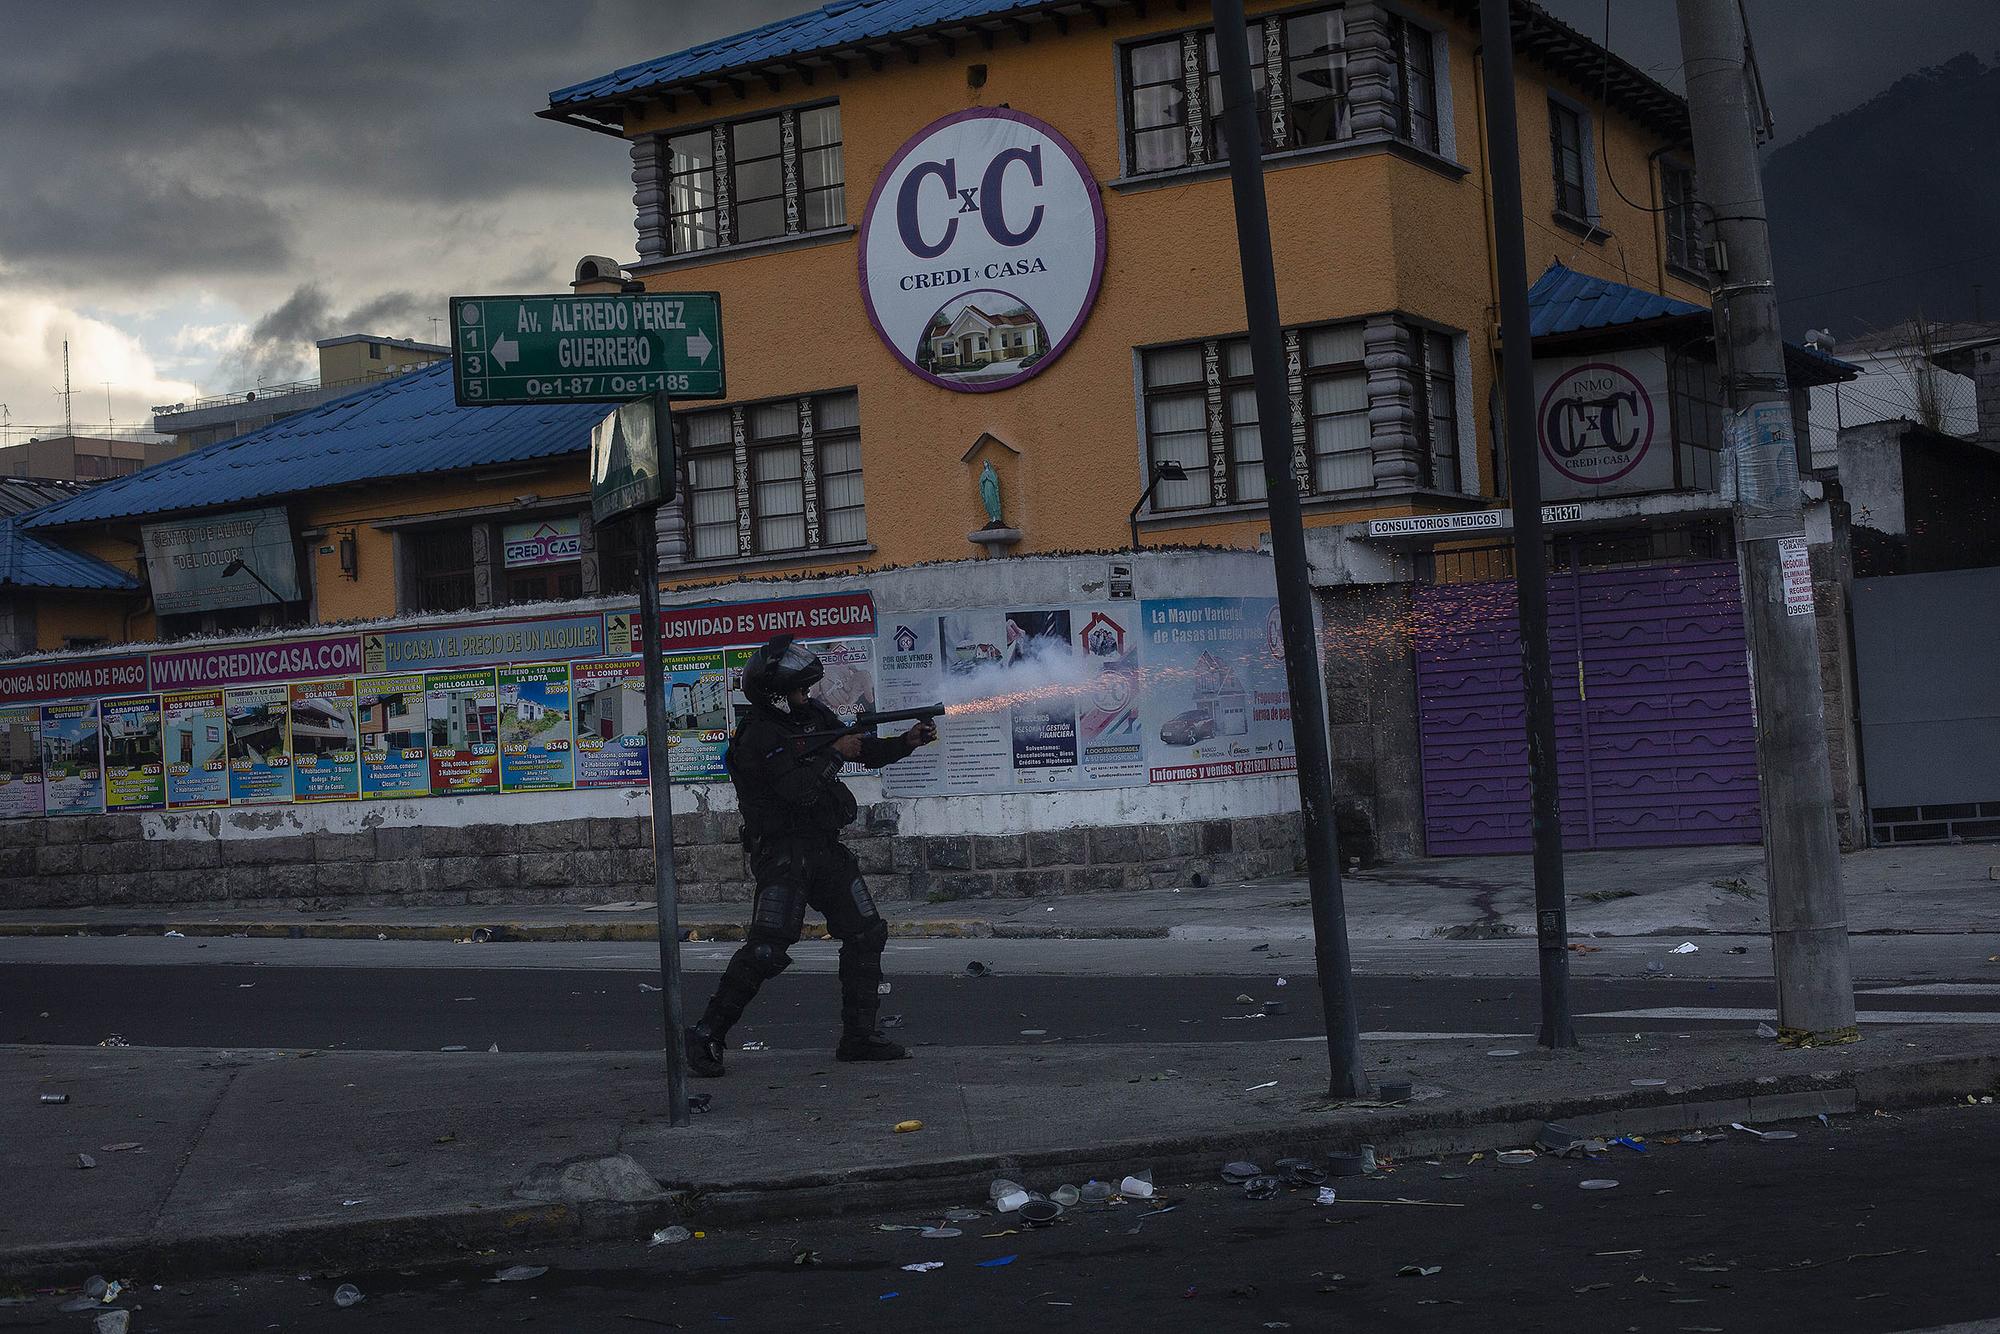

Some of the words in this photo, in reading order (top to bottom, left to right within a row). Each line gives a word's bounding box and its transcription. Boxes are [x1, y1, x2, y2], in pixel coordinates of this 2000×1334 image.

[899, 267, 970, 291] CREDI
[984, 258, 1047, 279] CASA
[517, 305, 542, 333] Av.
[551, 301, 627, 332] ALFREDO
[558, 336, 651, 368] GUERRERO
[526, 377, 594, 396] Oe1-87
[611, 374, 689, 393] Oe1-185
[1574, 378, 1613, 393] INMO
[1566, 458, 1598, 469] CREDI
[1603, 455, 1630, 464] CASA
[1557, 506, 1579, 520] 1317
[1375, 520, 1450, 533] CONSULTORIOS
[1452, 514, 1497, 527] MEDICOS
[152, 528, 195, 548] CENTRO
[200, 526, 214, 542] DE
[217, 520, 254, 539] ALIVIO
[507, 545, 542, 559] CREDI
[737, 617, 753, 632] ES
[758, 612, 804, 630] VENTA
[809, 606, 872, 628] SEGURA
[1152, 610, 1165, 624] La
[1168, 608, 1202, 623] Mayor
[1153, 629, 1168, 643] de
[1172, 628, 1205, 643] Casas
[1206, 629, 1216, 641] al
[387, 641, 403, 661] TU
[403, 639, 435, 660] CASA
[437, 637, 445, 657] X
[448, 636, 460, 656] EL
[462, 633, 502, 656] PRECIO
[506, 632, 521, 652] DE
[523, 630, 540, 651] UN
[543, 625, 599, 650] ALQUILER
[152, 643, 360, 683] WWW.CREDIXCASA.COM
[672, 662, 710, 671] KENNEDY
[37, 674, 50, 691] SU
[54, 669, 92, 690] FORMA
[95, 668, 110, 686] DE
[112, 665, 145, 684] PAGO
[434, 680, 485, 689] CHILLOGALLO
[305, 691, 337, 699] SOLANDA
[111, 705, 149, 714] CARAPUNGO
[185, 700, 214, 708] PUENTES
[1271, 708, 1279, 719] de
[701, 733, 725, 741] 2640
[1039, 730, 1074, 738] FINANCIERA
[546, 742, 568, 750] 8348
[624, 738, 645, 746] 3831
[405, 751, 423, 759] 2621
[144, 766, 160, 774] 2631
[207, 762, 223, 770] 1125
[269, 759, 289, 767] 8392
[1152, 767, 1197, 781] Informes
[1199, 770, 1205, 779] y
[1206, 765, 1234, 777] ventas:
